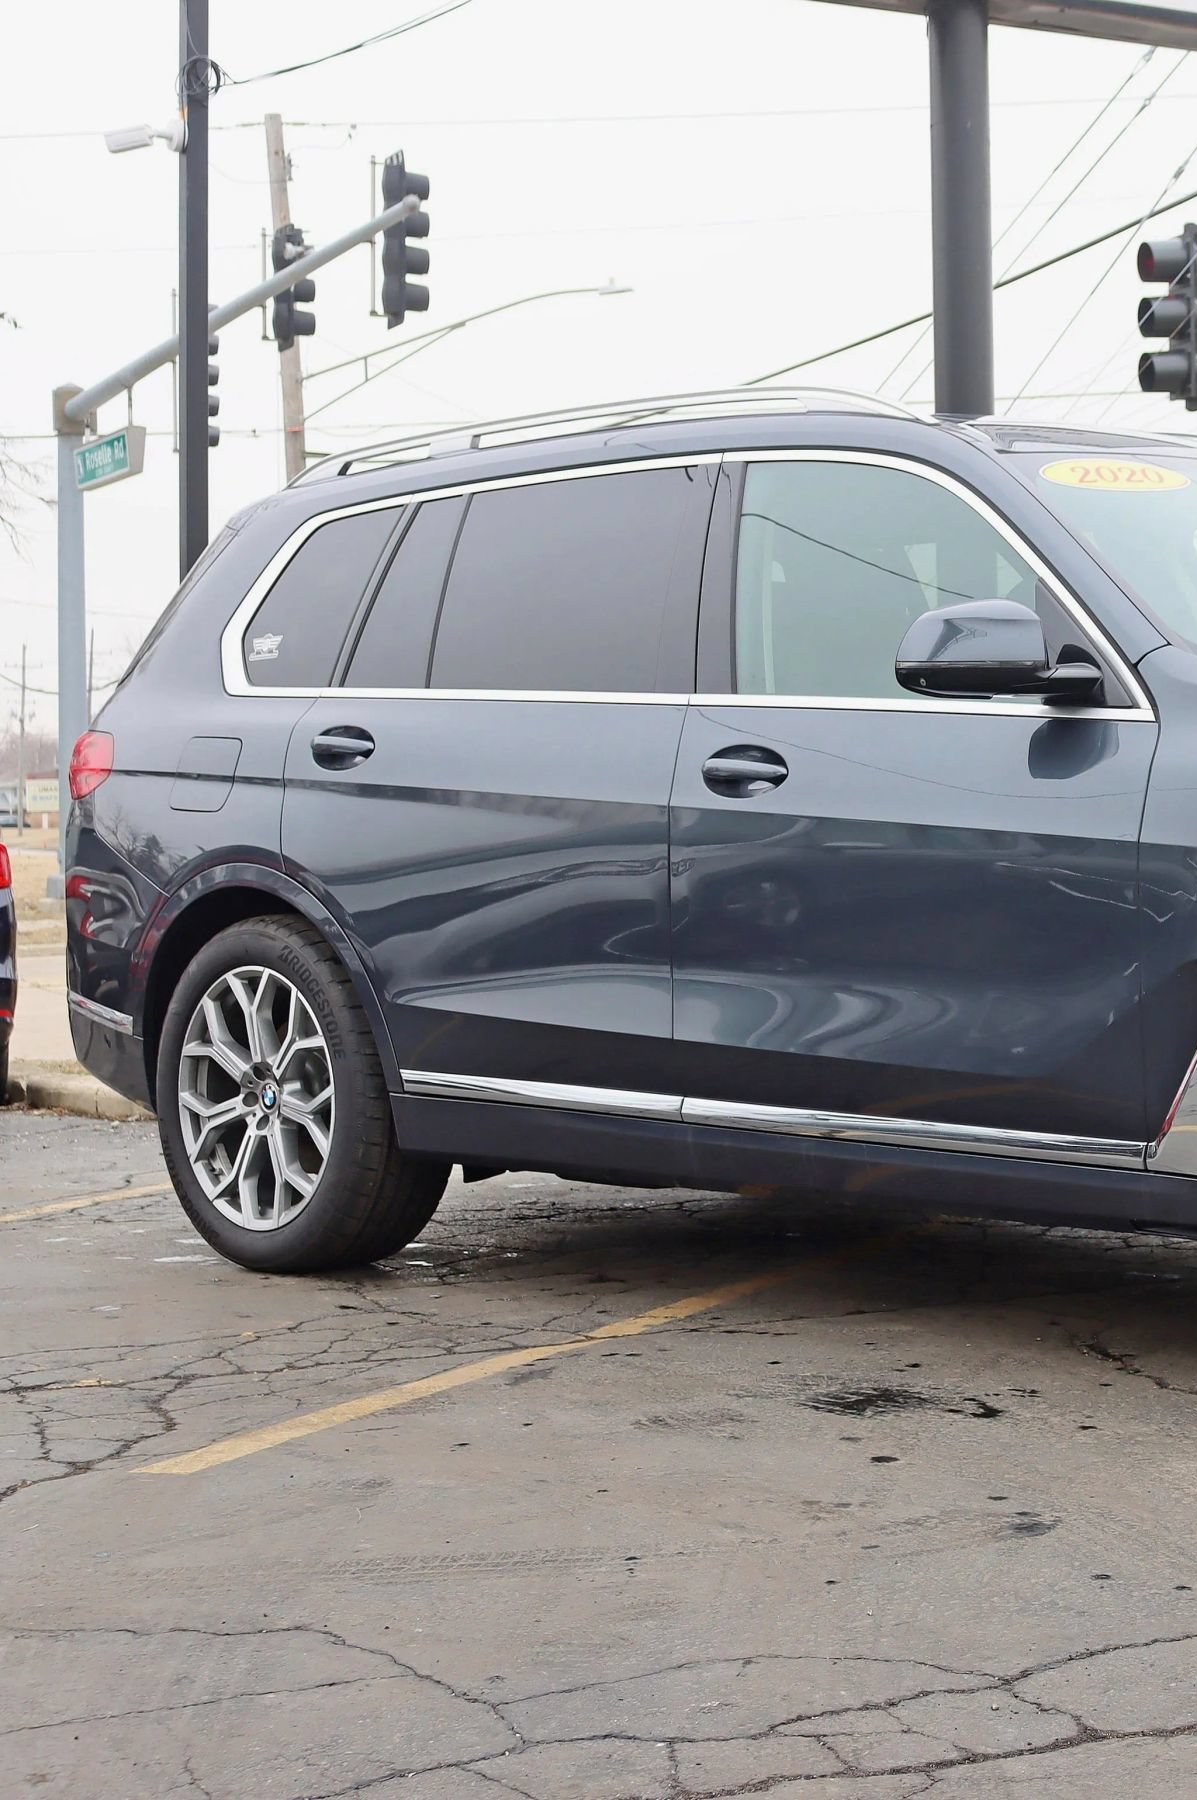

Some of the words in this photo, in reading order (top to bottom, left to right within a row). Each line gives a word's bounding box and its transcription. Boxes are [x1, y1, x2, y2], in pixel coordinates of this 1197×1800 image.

[85, 443, 112, 471] Roselle
[113, 437, 125, 461] Rd
[1070, 465, 1165, 484] 2020
[279, 944, 346, 1060] BRIDGESTONE
